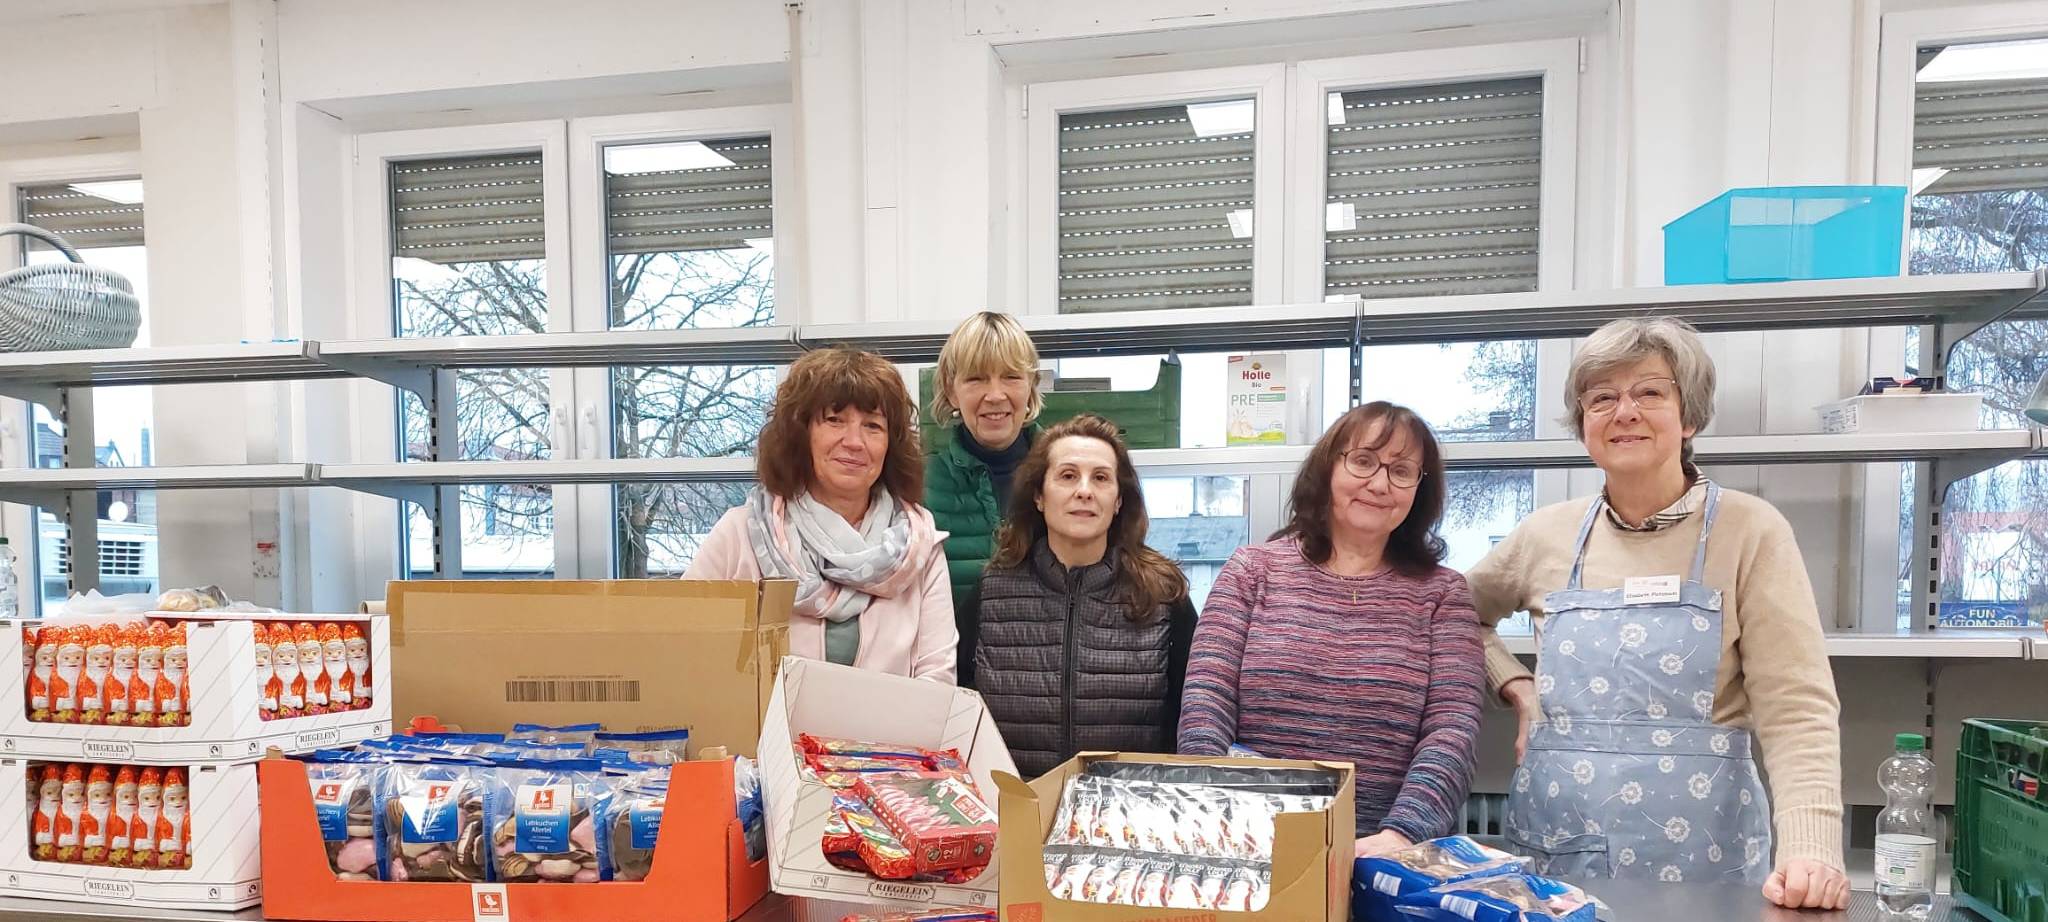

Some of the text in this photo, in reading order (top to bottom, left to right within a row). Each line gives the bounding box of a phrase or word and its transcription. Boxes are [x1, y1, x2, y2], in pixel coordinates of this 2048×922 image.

[1243, 371, 1271, 380] Holle
[1231, 394, 1255, 406] PRE
[1969, 609, 1995, 619] FUN
[300, 730, 336, 743] RIEGELEIN
[87, 743, 129, 753] RIEGELEIN
[88, 881, 130, 891] RIEGELEIN
[876, 883, 929, 895] RIEGELEIN
